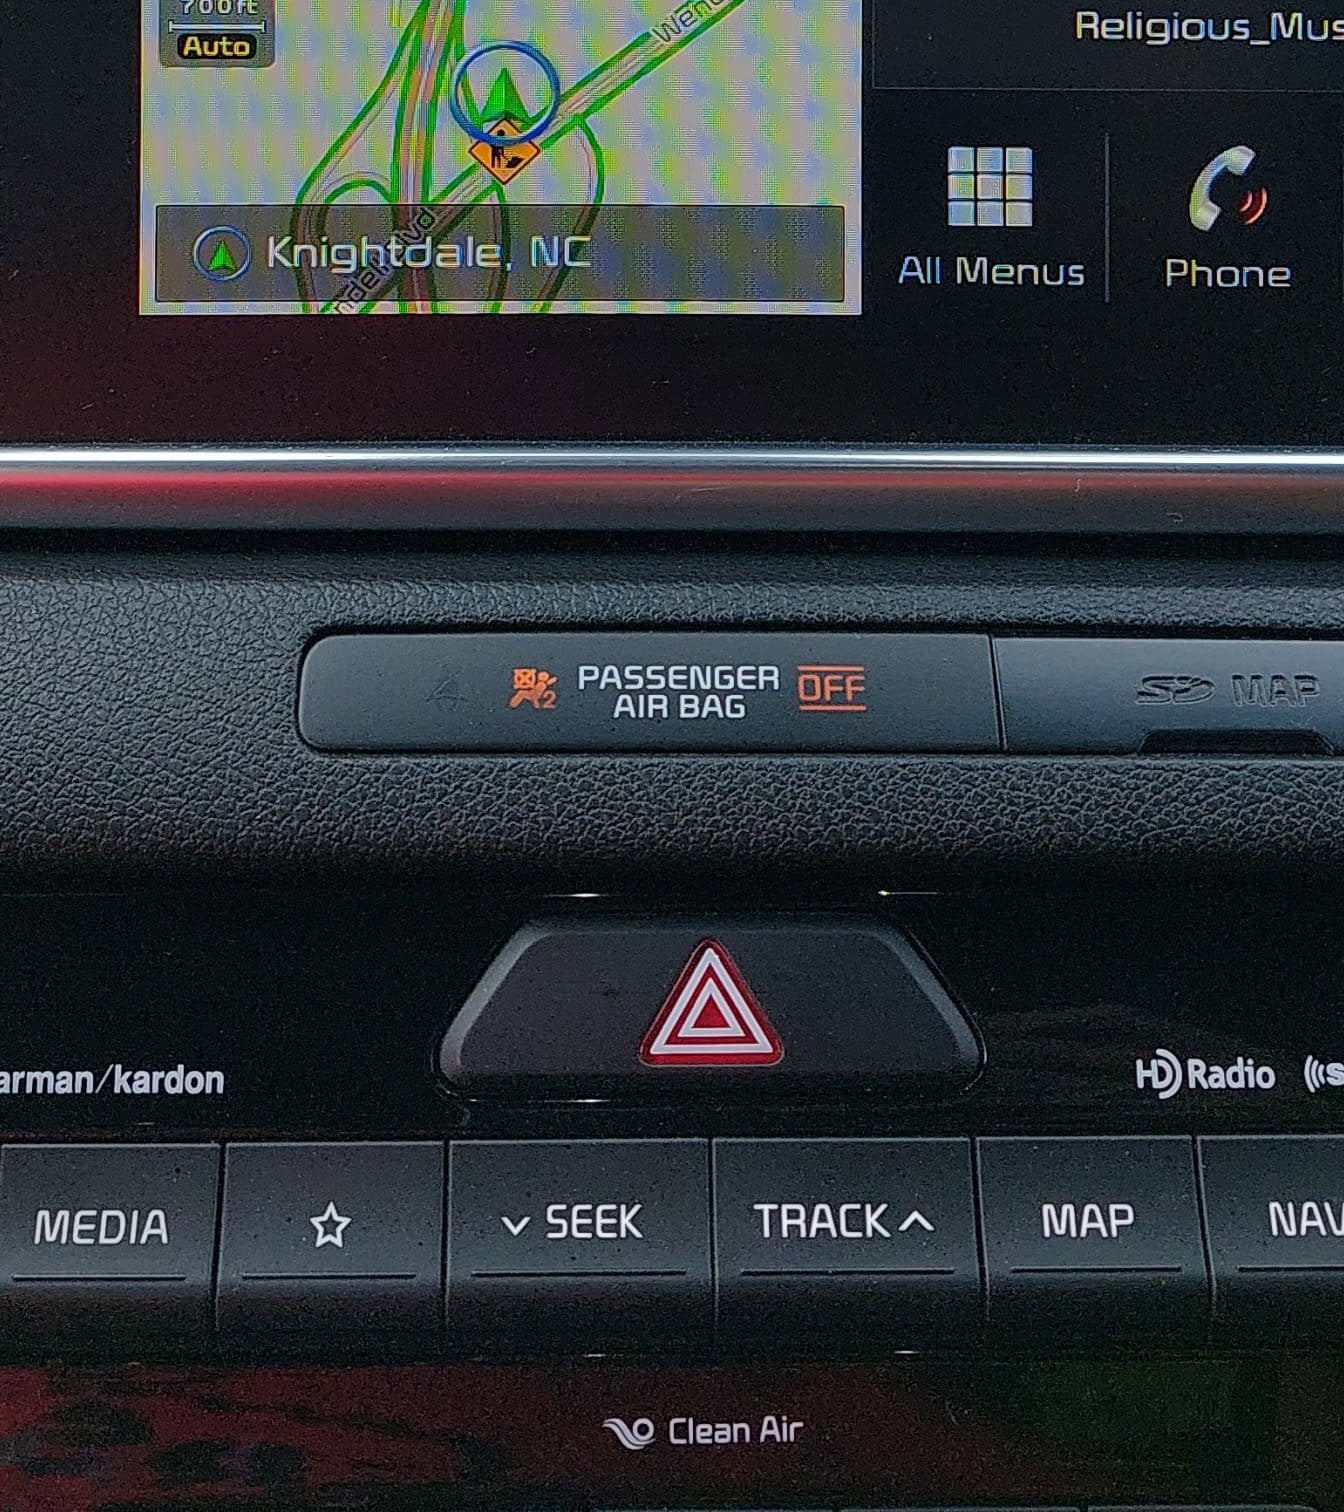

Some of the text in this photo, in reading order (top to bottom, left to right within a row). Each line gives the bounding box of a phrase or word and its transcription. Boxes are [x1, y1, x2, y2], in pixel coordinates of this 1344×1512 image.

[183, 36, 251, 56] Auto
[267, 236, 591, 274] Knightdale, NC
[898, 255, 1085, 286] All Menus
[1166, 258, 1292, 288] Phone
[578, 665, 779, 690] PASSENGER
[799, 676, 864, 701] OFF
[1231, 674, 1320, 706] MAP
[613, 694, 746, 719] AIR BAG
[1186, 1056, 1276, 1089] Radio
[34, 1209, 168, 1245] MEDIA
[546, 1204, 643, 1239] SEEK
[753, 1203, 891, 1238] TRACK
[1042, 1203, 1134, 1238] MAP
[669, 1415, 804, 1445] Clean Air
